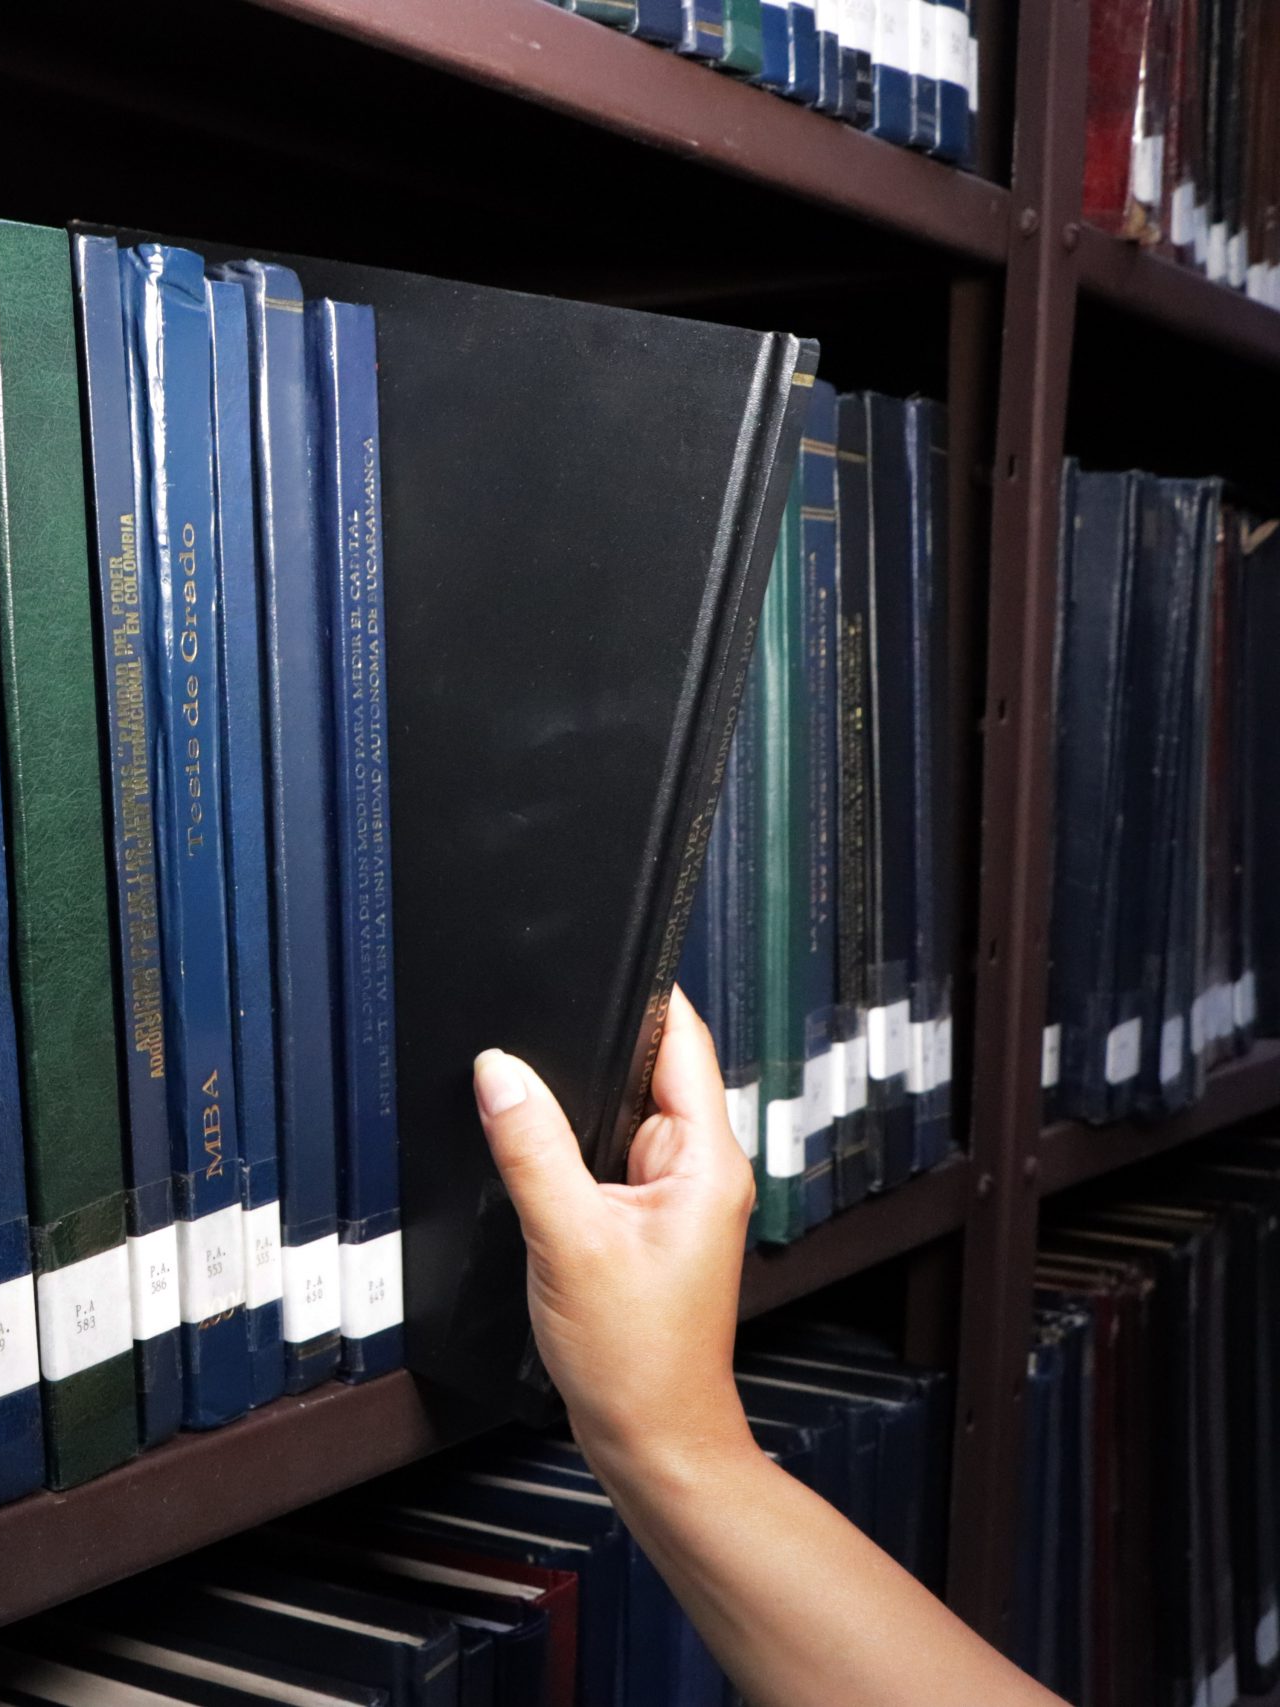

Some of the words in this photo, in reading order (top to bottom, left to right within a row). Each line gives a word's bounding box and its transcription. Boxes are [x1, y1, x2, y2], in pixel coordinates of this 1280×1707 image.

[109, 557, 125, 614] PODER
[120, 514, 138, 603] COLOMBIA
[178, 522, 198, 664] Grado
[351, 606, 361, 628] EL
[126, 612, 139, 634] EN
[368, 608, 378, 634] DE
[352, 633, 363, 698] MEDIR
[182, 674, 199, 728] de
[368, 639, 381, 763] AUTONOMA
[712, 706, 738, 784] MUNDO
[731, 670, 746, 697] DE
[354, 704, 365, 757] PARA
[184, 737, 205, 857] Tesis
[355, 763, 367, 850] MODELO
[358, 856, 368, 888] UN
[375, 912, 386, 938] LA
[646, 988, 663, 1015] EL
[673, 864, 692, 904] DEL
[202, 1069, 224, 1181] MBA
[150, 1263, 170, 1278] P.A.
[151, 1278, 167, 1295] 586
[77, 1315, 96, 1334] 583
